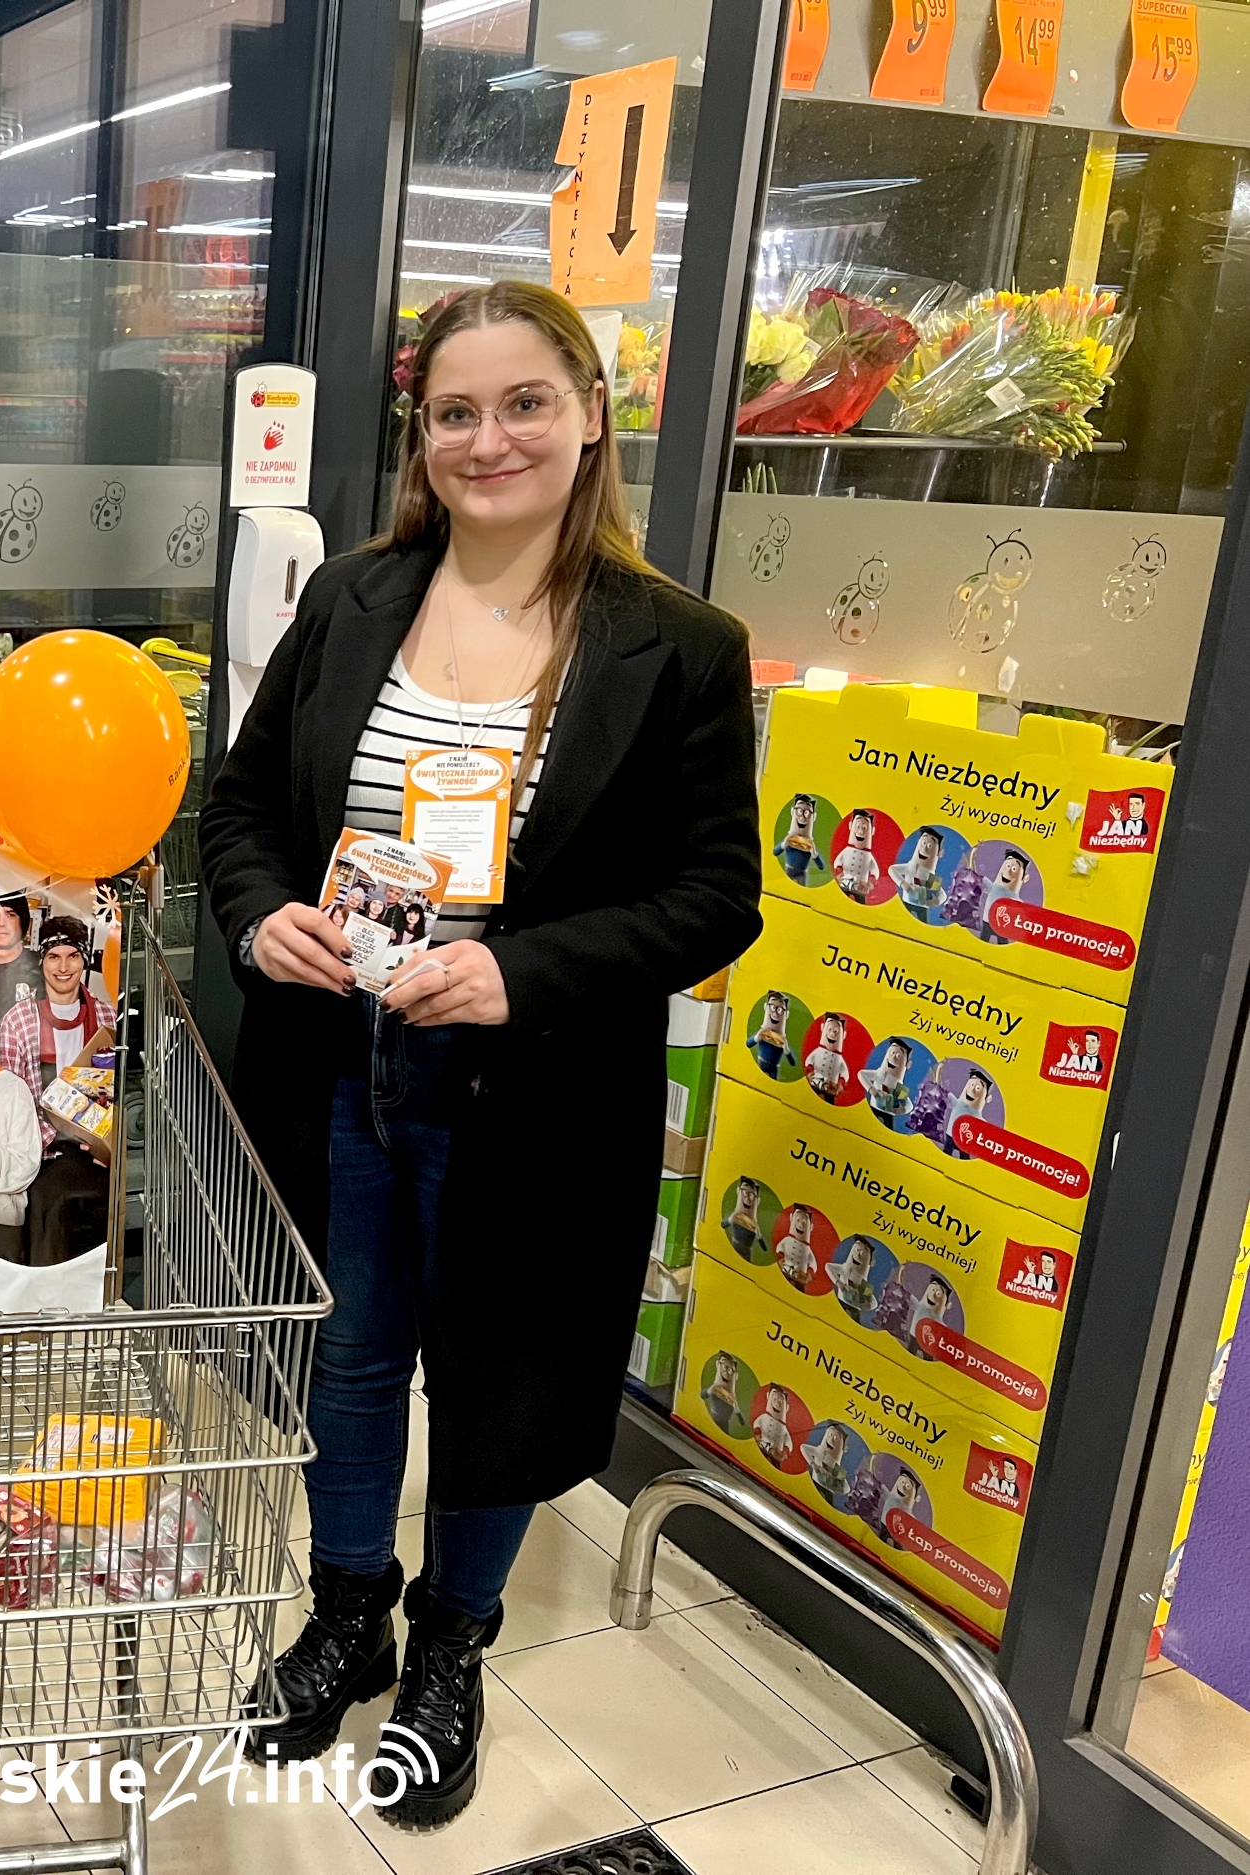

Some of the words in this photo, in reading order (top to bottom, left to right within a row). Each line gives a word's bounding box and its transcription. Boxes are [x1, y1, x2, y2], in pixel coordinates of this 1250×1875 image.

[1137, 0, 1187, 16] SUPERCENA
[246, 461, 258, 471] NIE
[260, 461, 297, 472] ZAPOMNIJ
[168, 758, 186, 786] Bank
[416, 769, 465, 779] ŚWIĄTECZNA
[466, 768, 500, 776] ZBIÓRKA
[436, 777, 478, 786] ŻYWNOŚCI
[848, 739, 899, 772] Jan
[905, 751, 1061, 811] Niezbędny
[940, 794, 965, 820] Żyj
[967, 806, 1058, 838] wygodniej!
[1097, 820, 1144, 837] JAN
[1089, 835, 1148, 849] Niezbędny
[351, 848, 399, 871] ŚWIĄTECZNA
[400, 866, 432, 884] ZBIÓRKA
[370, 863, 410, 883] ŻYWNOŚCI
[1014, 914, 1043, 939] Łap
[1045, 925, 1126, 959] promocje!
[821, 945, 871, 980] Jan
[877, 963, 1023, 1036] Niezbędny
[909, 1009, 933, 1033] Żyj
[935, 1025, 1020, 1063] wygodniej!
[1048, 1066, 1102, 1084] Niezbędny
[1056, 1053, 1098, 1072] JAN
[976, 1130, 1004, 1156] Łap
[1006, 1147, 1082, 1188] promocje!
[790, 1139, 836, 1177] Jan
[841, 1162, 982, 1247] Niezbędny
[872, 1210, 895, 1235] Żyj
[898, 1227, 977, 1274] wygodniej!
[1005, 1281, 1058, 1304] Niezbędny
[1013, 1270, 1054, 1292] JAN
[937, 1335, 964, 1361] Łap
[965, 1352, 1039, 1400] promocje!
[766, 1321, 811, 1362] Jan
[815, 1348, 948, 1445] Niezbędny
[844, 1399, 868, 1425] Żyj
[868, 1416, 945, 1470] wygodniej!
[971, 1482, 1019, 1509] Niezbędny
[978, 1472, 1015, 1497] JAN
[907, 1527, 933, 1554] Łap
[934, 1546, 1002, 1599] promocje!
